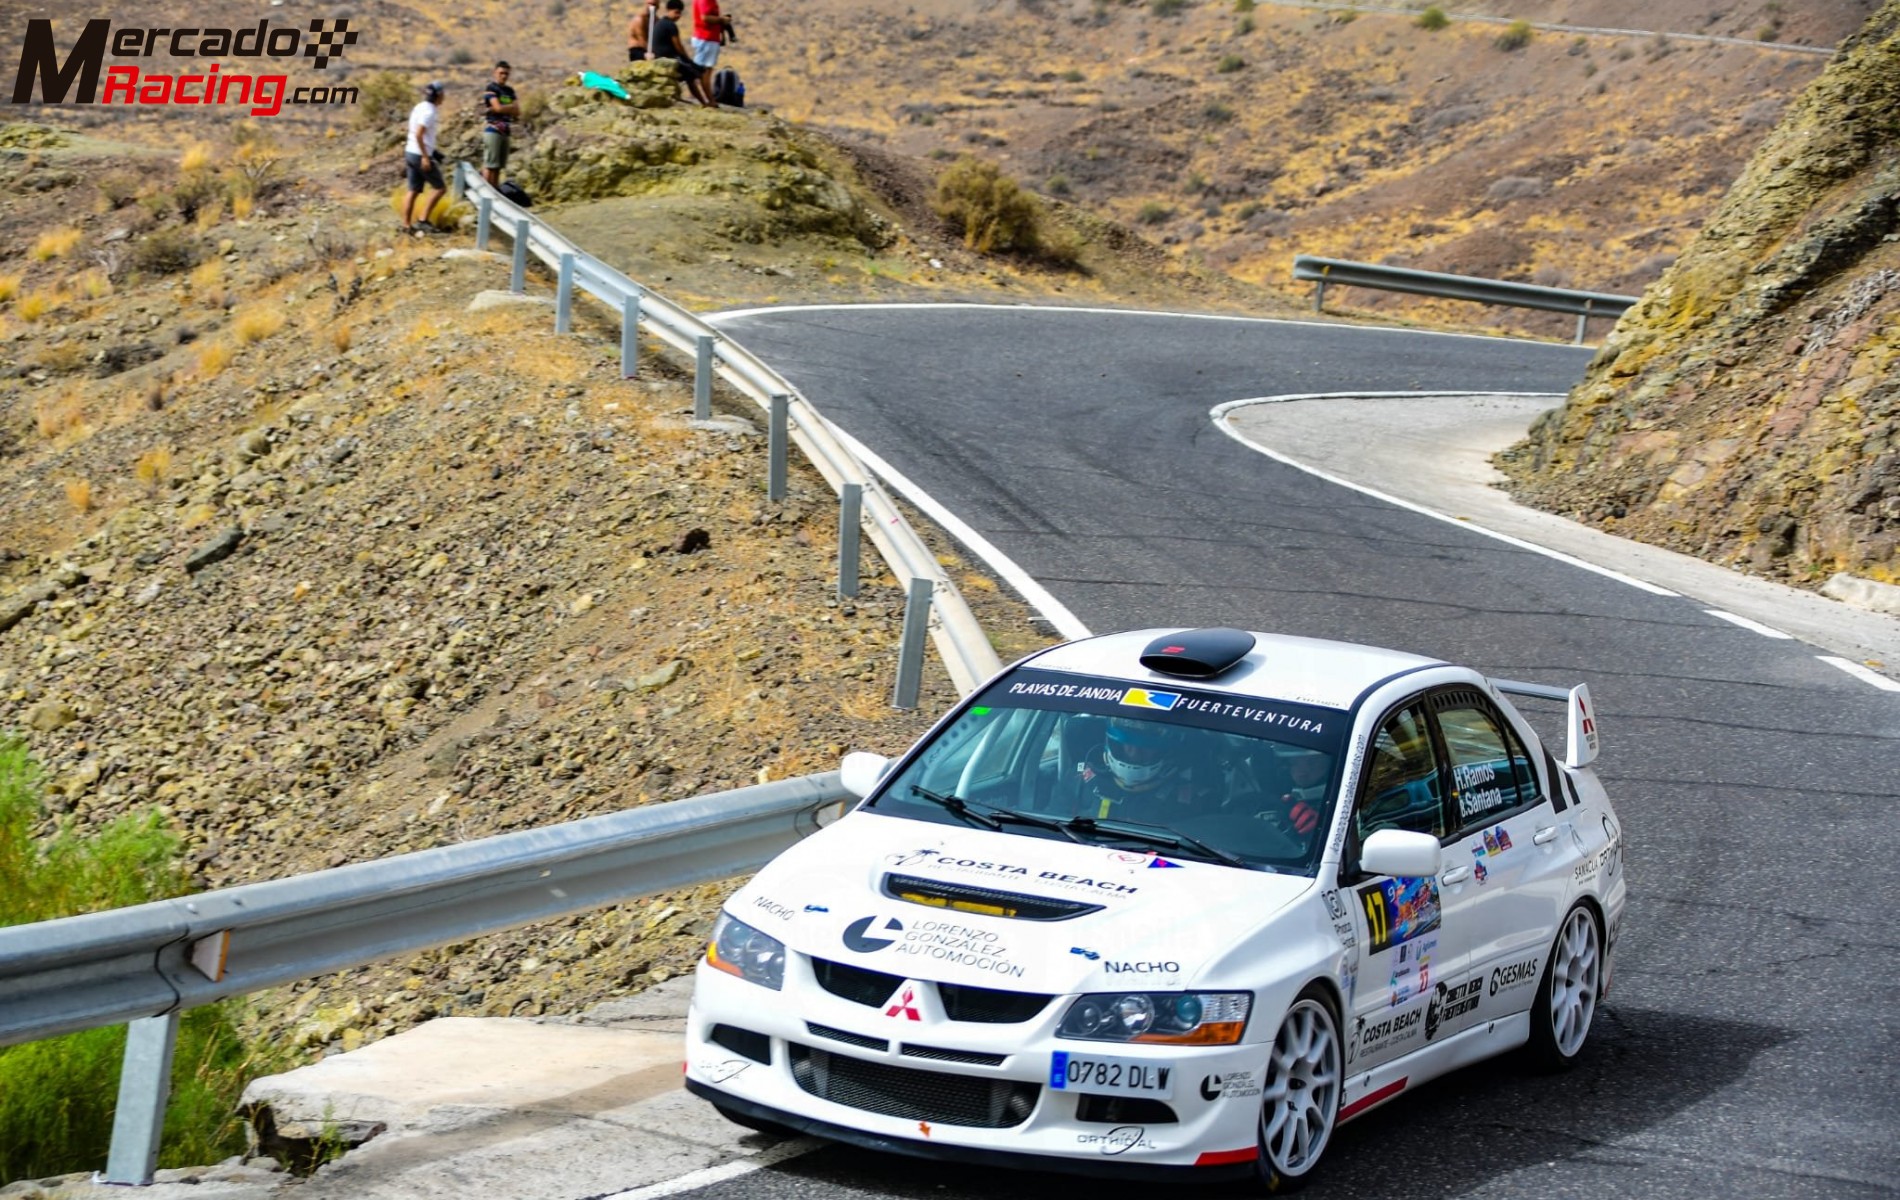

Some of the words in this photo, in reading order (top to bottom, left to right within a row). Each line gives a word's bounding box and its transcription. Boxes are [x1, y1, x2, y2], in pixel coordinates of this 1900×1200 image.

[1009, 682, 1058, 696] PLAYAS
[1056, 685, 1078, 697] DE
[1073, 687, 1123, 702] JANDIA
[1176, 697, 1323, 734] FUERTEVENTURA
[1453, 763, 1495, 791] H.Ramos
[938, 857, 1028, 875] COSTA
[1039, 871, 1139, 894] BEACH
[753, 895, 796, 921] NACHO
[1366, 891, 1387, 946] 17
[912, 920, 999, 943] LORENZO
[894, 943, 1026, 979] AUTOMOCIÓN
[1104, 960, 1180, 974] NACHO
[1500, 958, 1538, 986] GESMAS
[1363, 1019, 1392, 1045] COSTA
[1392, 1007, 1422, 1033] BEACH
[1068, 1060, 1122, 1087] 0782
[1128, 1065, 1171, 1090] DLW
